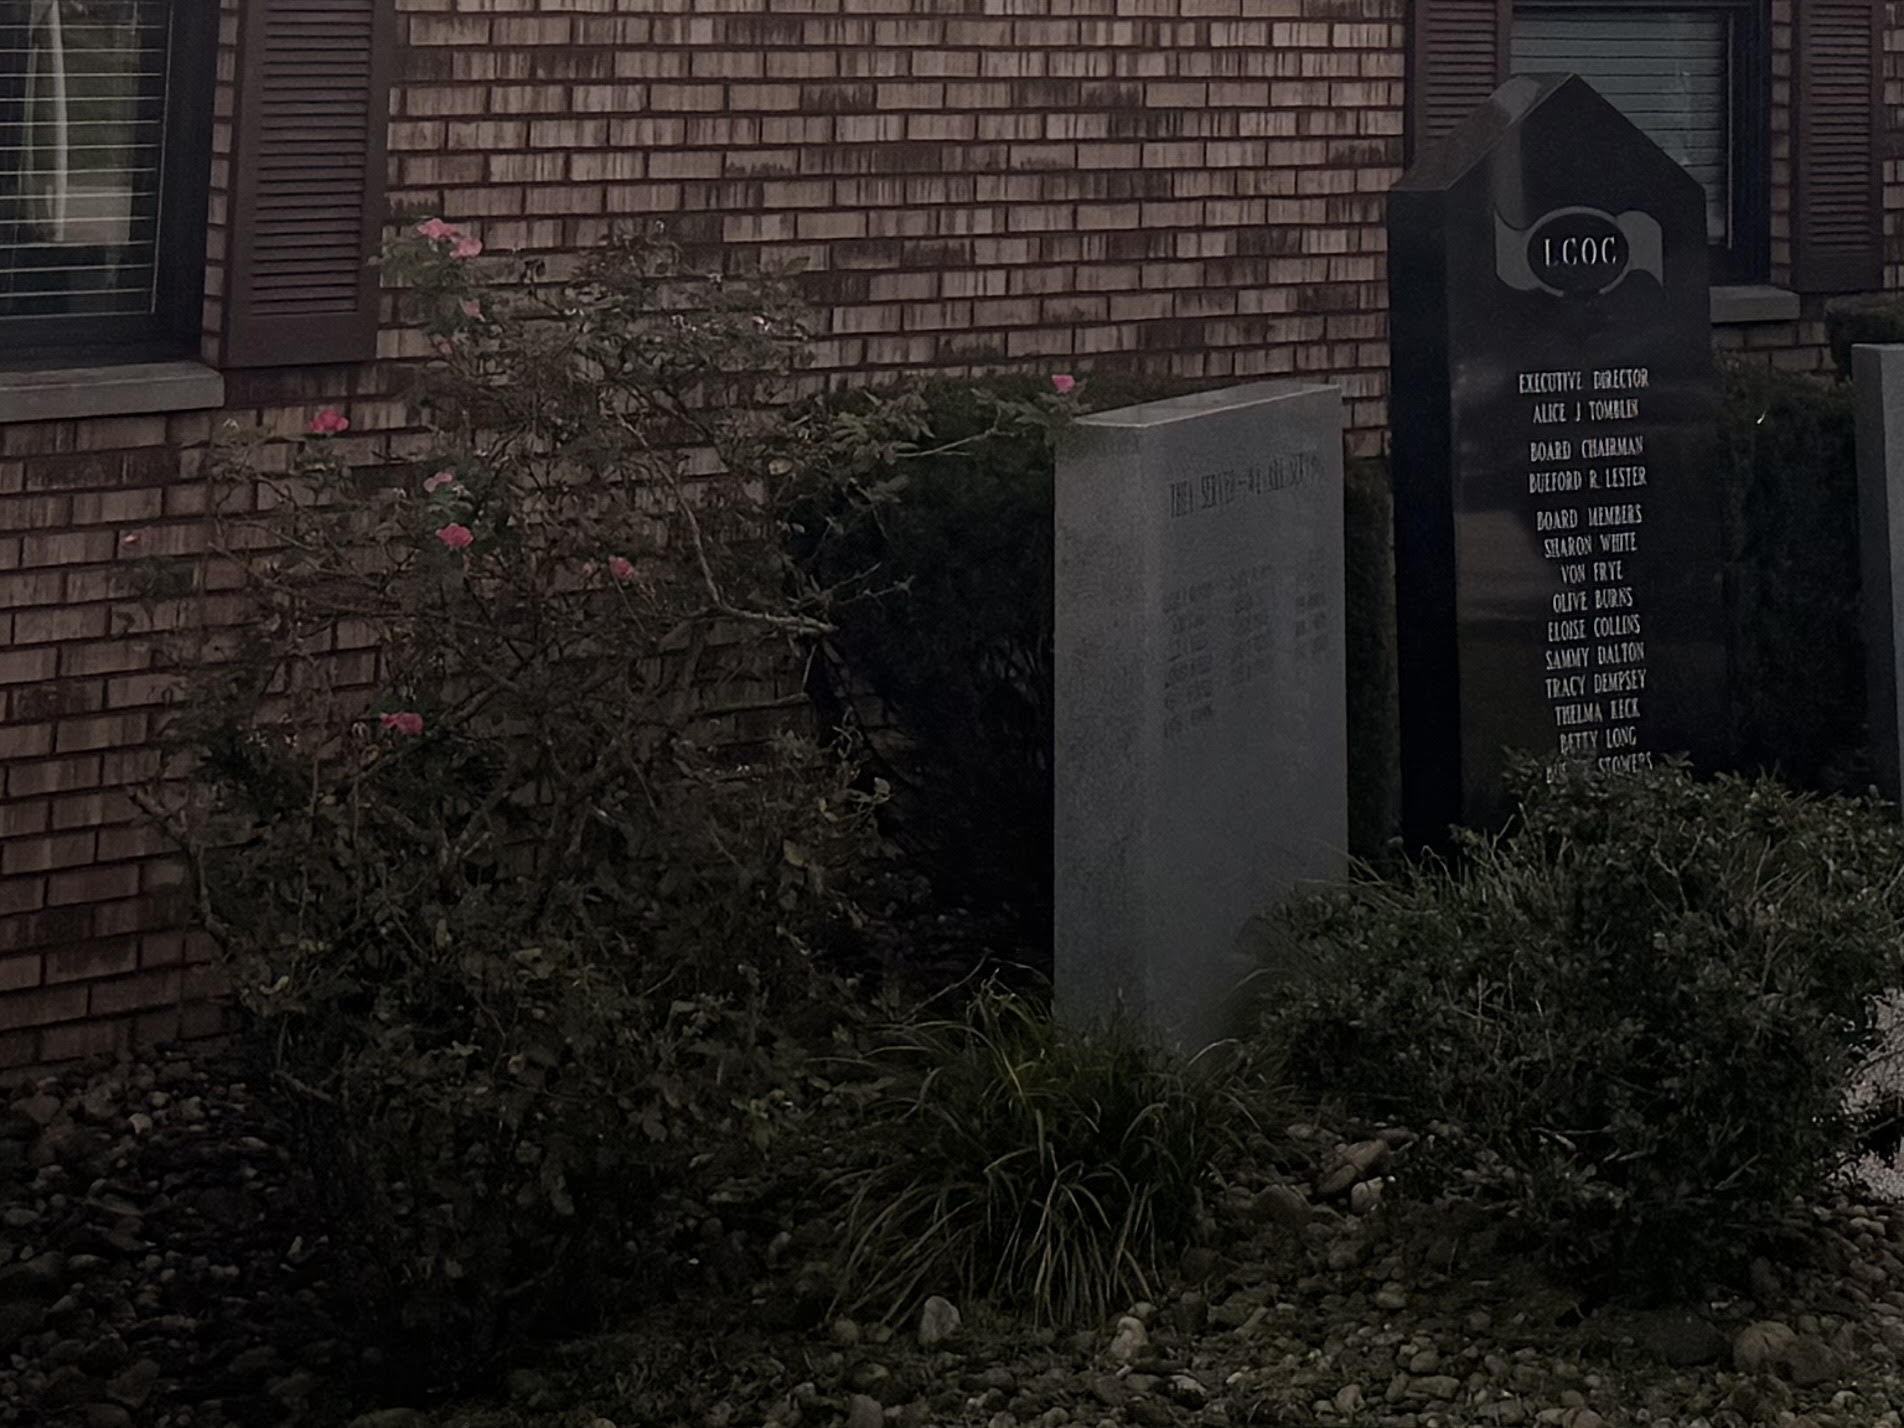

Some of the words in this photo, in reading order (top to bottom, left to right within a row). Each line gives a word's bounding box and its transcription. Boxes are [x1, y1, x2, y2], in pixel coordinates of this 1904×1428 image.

[1519, 371, 1582, 394] EXECUTIVE
[1593, 368, 1649, 390] DIRECTOR
[1533, 403, 1567, 424] ALICE
[1589, 398, 1639, 421] TOMBLIN
[1530, 441, 1572, 462] BOARD
[1581, 435, 1644, 459] CHAIRMAN
[1605, 466, 1648, 488] LESTER
[1537, 509, 1578, 531] BOARD
[1588, 504, 1642, 527] MEMBERS
[1544, 535, 1592, 558] SHARON
[1600, 532, 1638, 553] WHITE
[1561, 564, 1585, 584] VON
[1594, 560, 1623, 582] FRYE
[1553, 592, 1588, 613] OLIVE
[1595, 587, 1633, 609] BURNS
[1548, 619, 1586, 642] ELOISE
[1594, 614, 1641, 638] COLLINS
[1545, 648, 1589, 670] SAMMY
[1598, 642, 1645, 665] DALTON
[1545, 677, 1586, 699] TRACY
[1594, 669, 1647, 694] DEMPSEY
[1555, 702, 1603, 727] THELMA
[1610, 697, 1640, 720] KECK
[1559, 731, 1598, 753] BETTY
[1606, 726, 1636, 749] LONG
[1598, 751, 1653, 775] STOWERS
